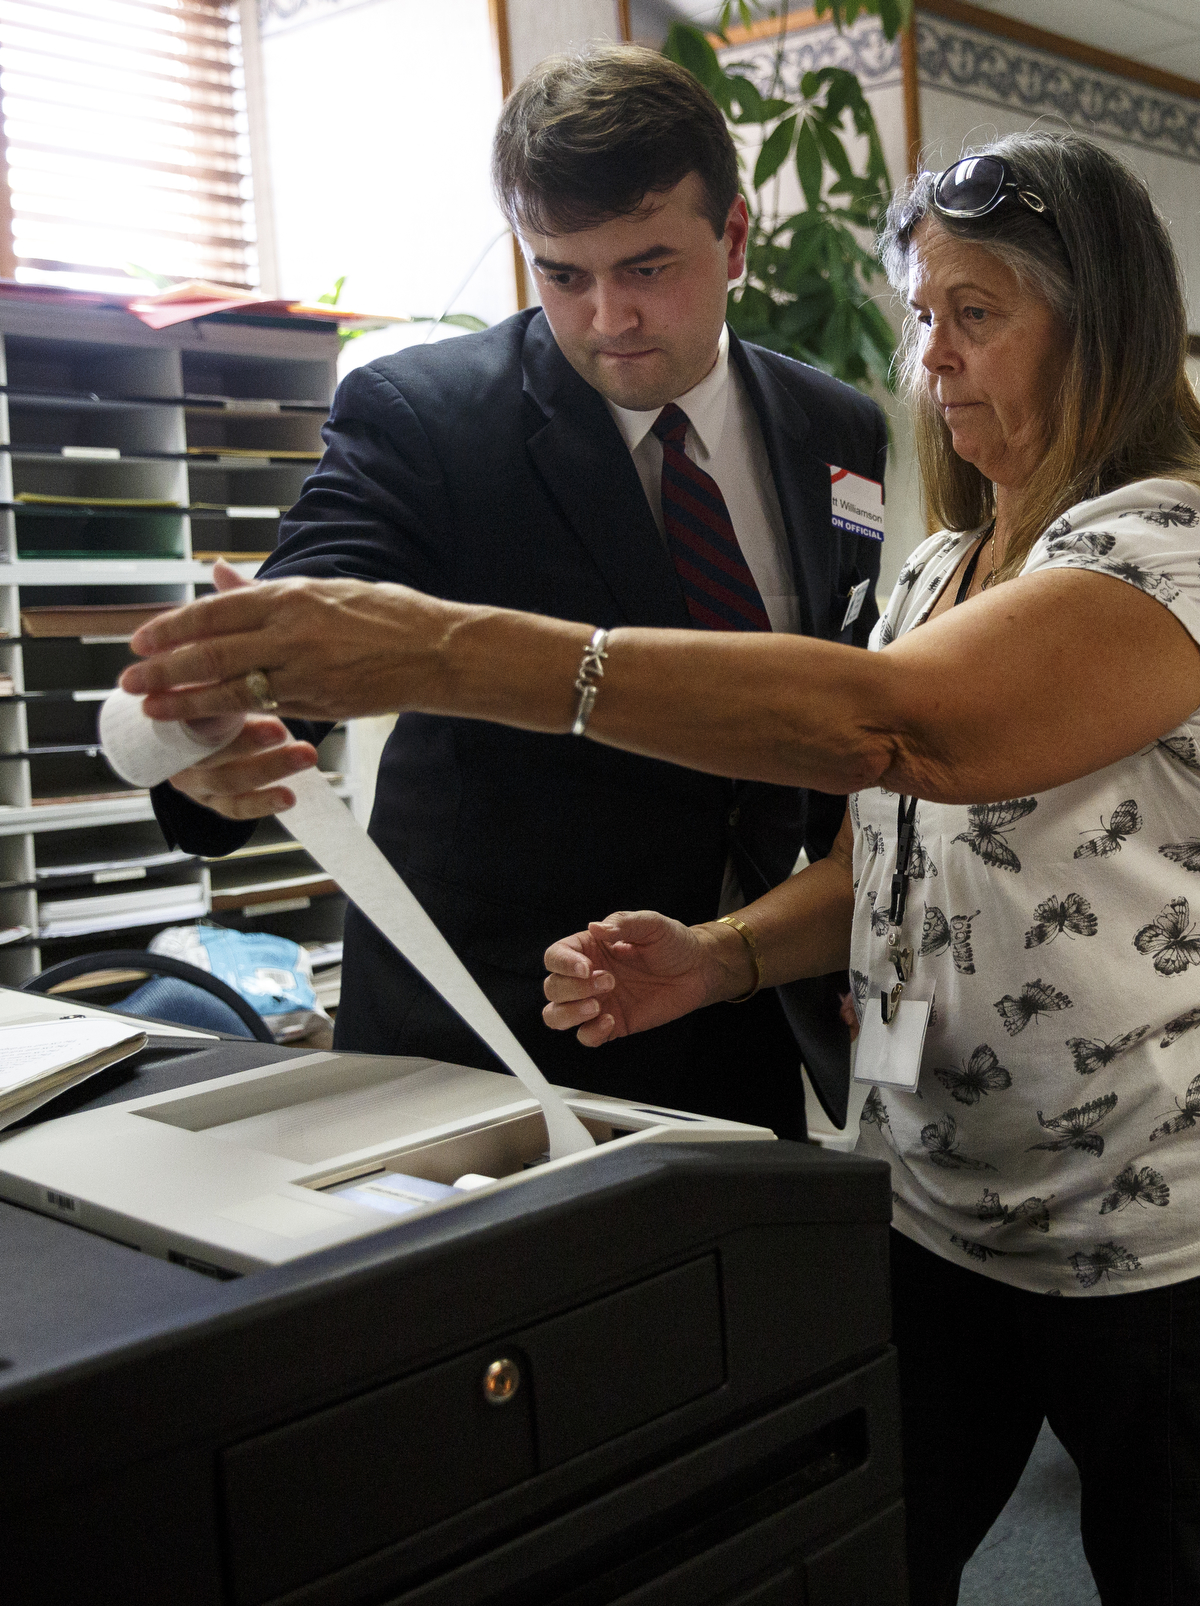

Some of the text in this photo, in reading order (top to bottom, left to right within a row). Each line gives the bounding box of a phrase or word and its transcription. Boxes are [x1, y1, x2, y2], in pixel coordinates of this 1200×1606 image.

[840, 499, 882, 523] Williamson
[832, 517, 882, 540] ON OFFICIAL
